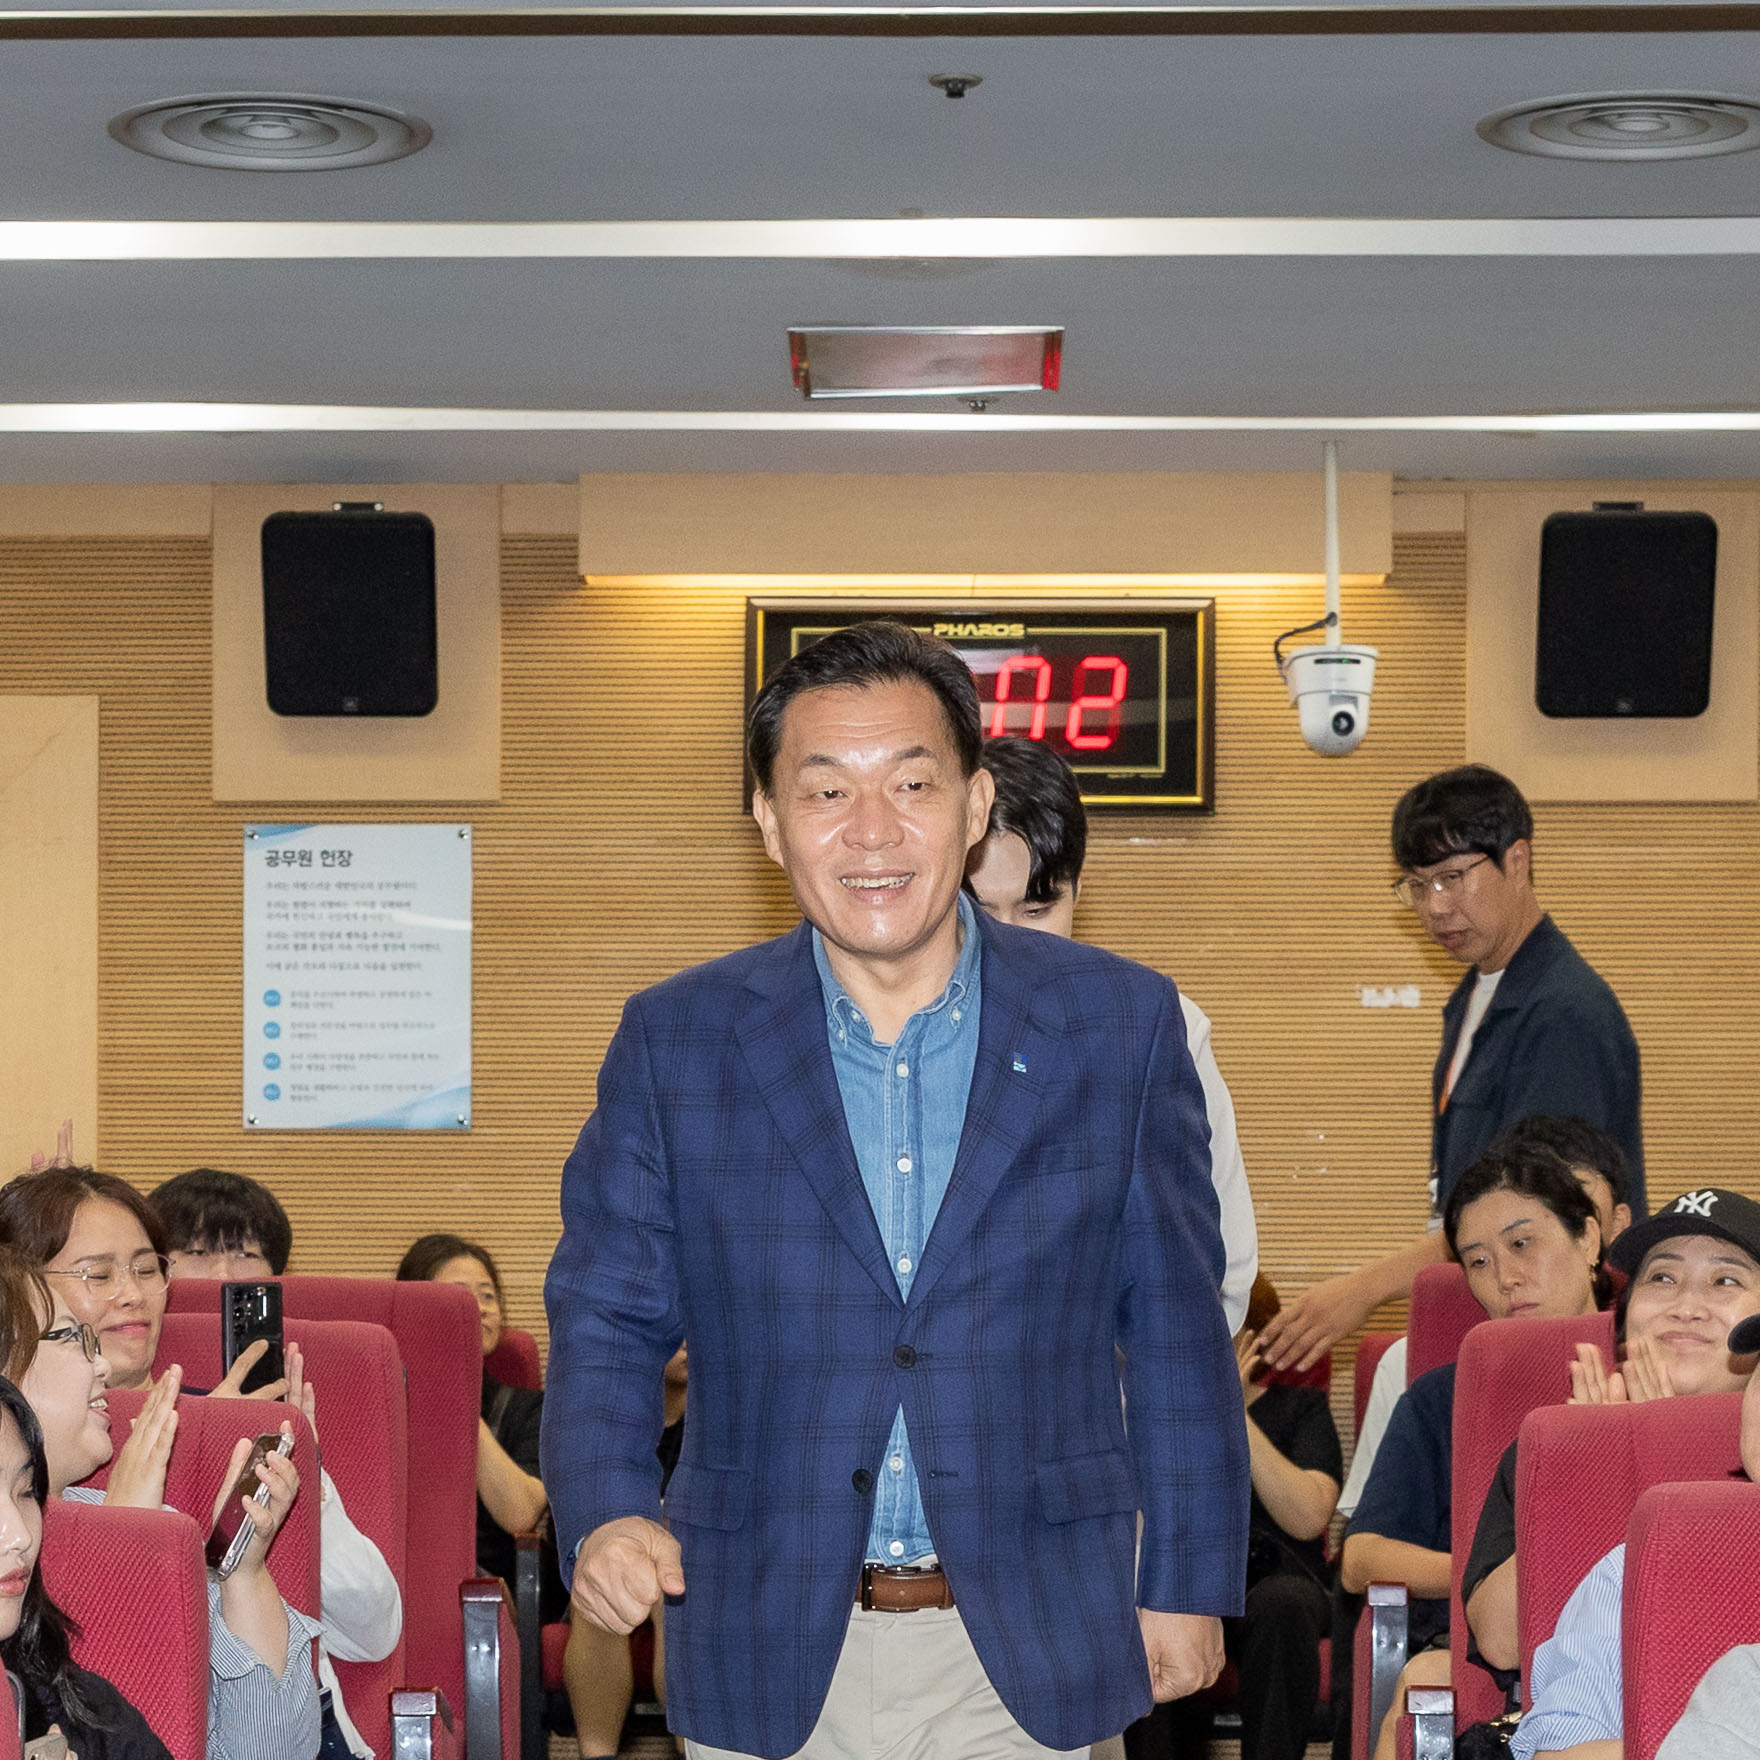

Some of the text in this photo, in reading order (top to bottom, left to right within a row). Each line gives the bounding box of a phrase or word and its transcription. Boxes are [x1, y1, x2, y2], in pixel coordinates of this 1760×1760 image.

[933, 623, 1024, 637] PHAROS
[264, 850, 353, 868] 공무원 헌장
[1673, 1190, 1719, 1218] NY
